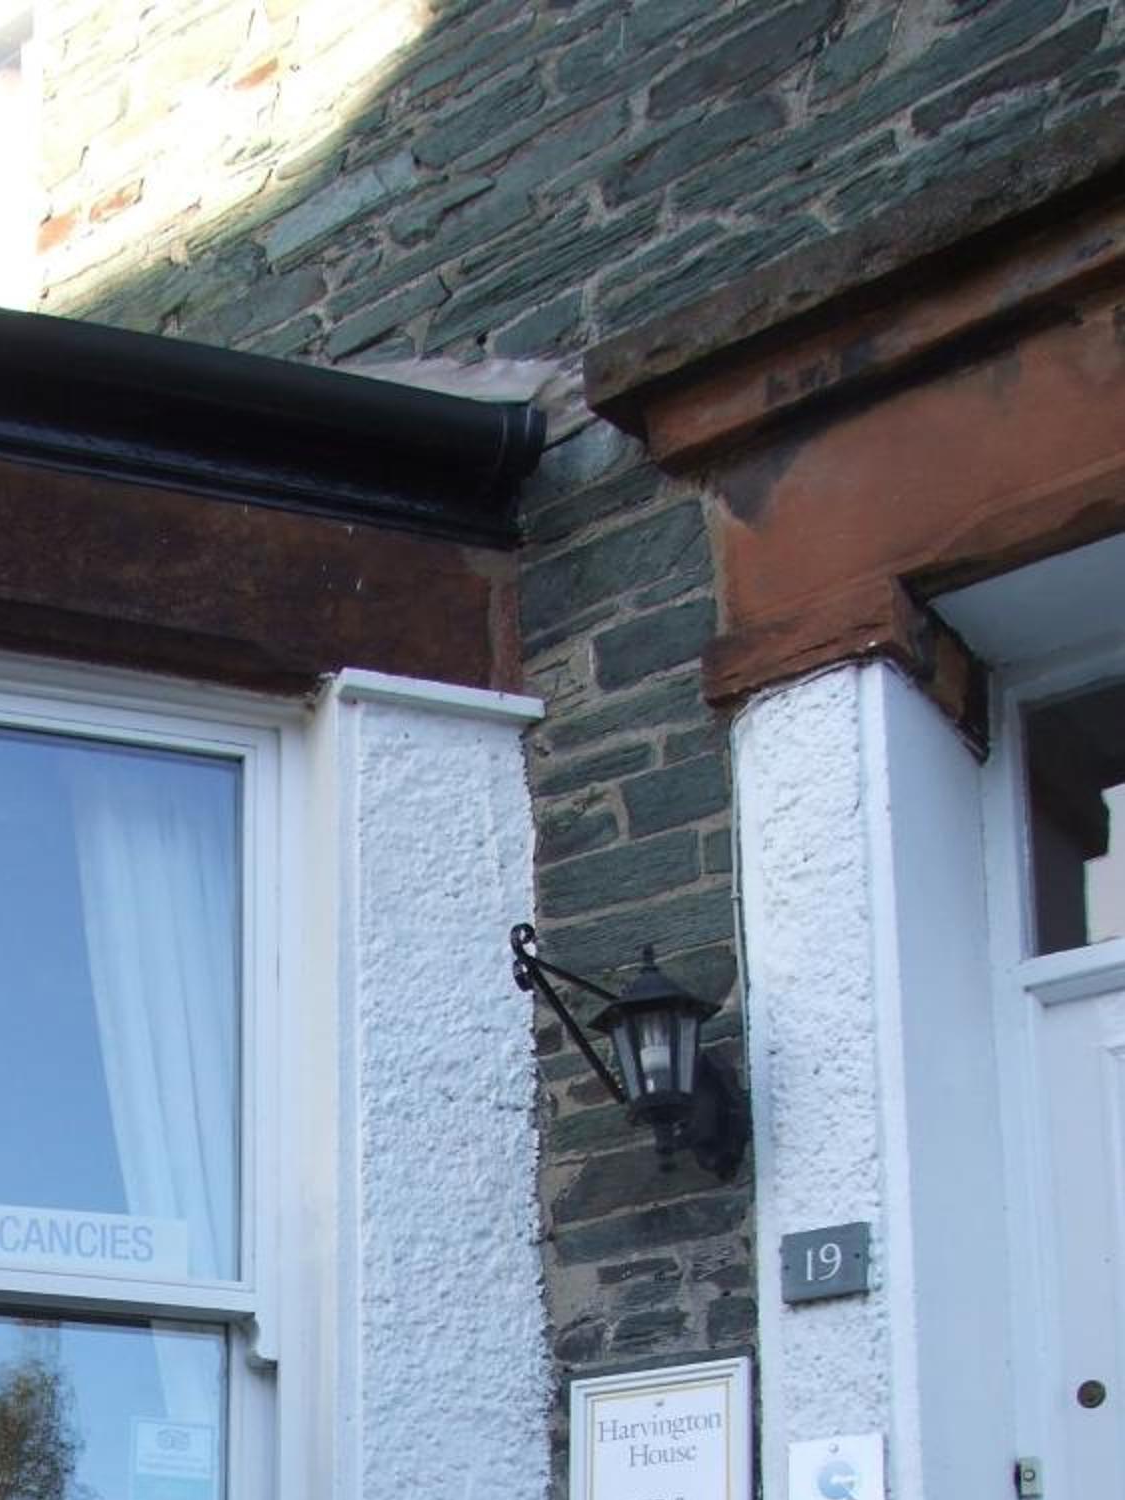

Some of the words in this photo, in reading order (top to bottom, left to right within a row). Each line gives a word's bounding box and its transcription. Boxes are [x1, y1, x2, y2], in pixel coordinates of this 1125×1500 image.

[805, 1242, 842, 1281] 19
[597, 1410, 722, 1442] Harvington
[628, 1442, 697, 1468] House
